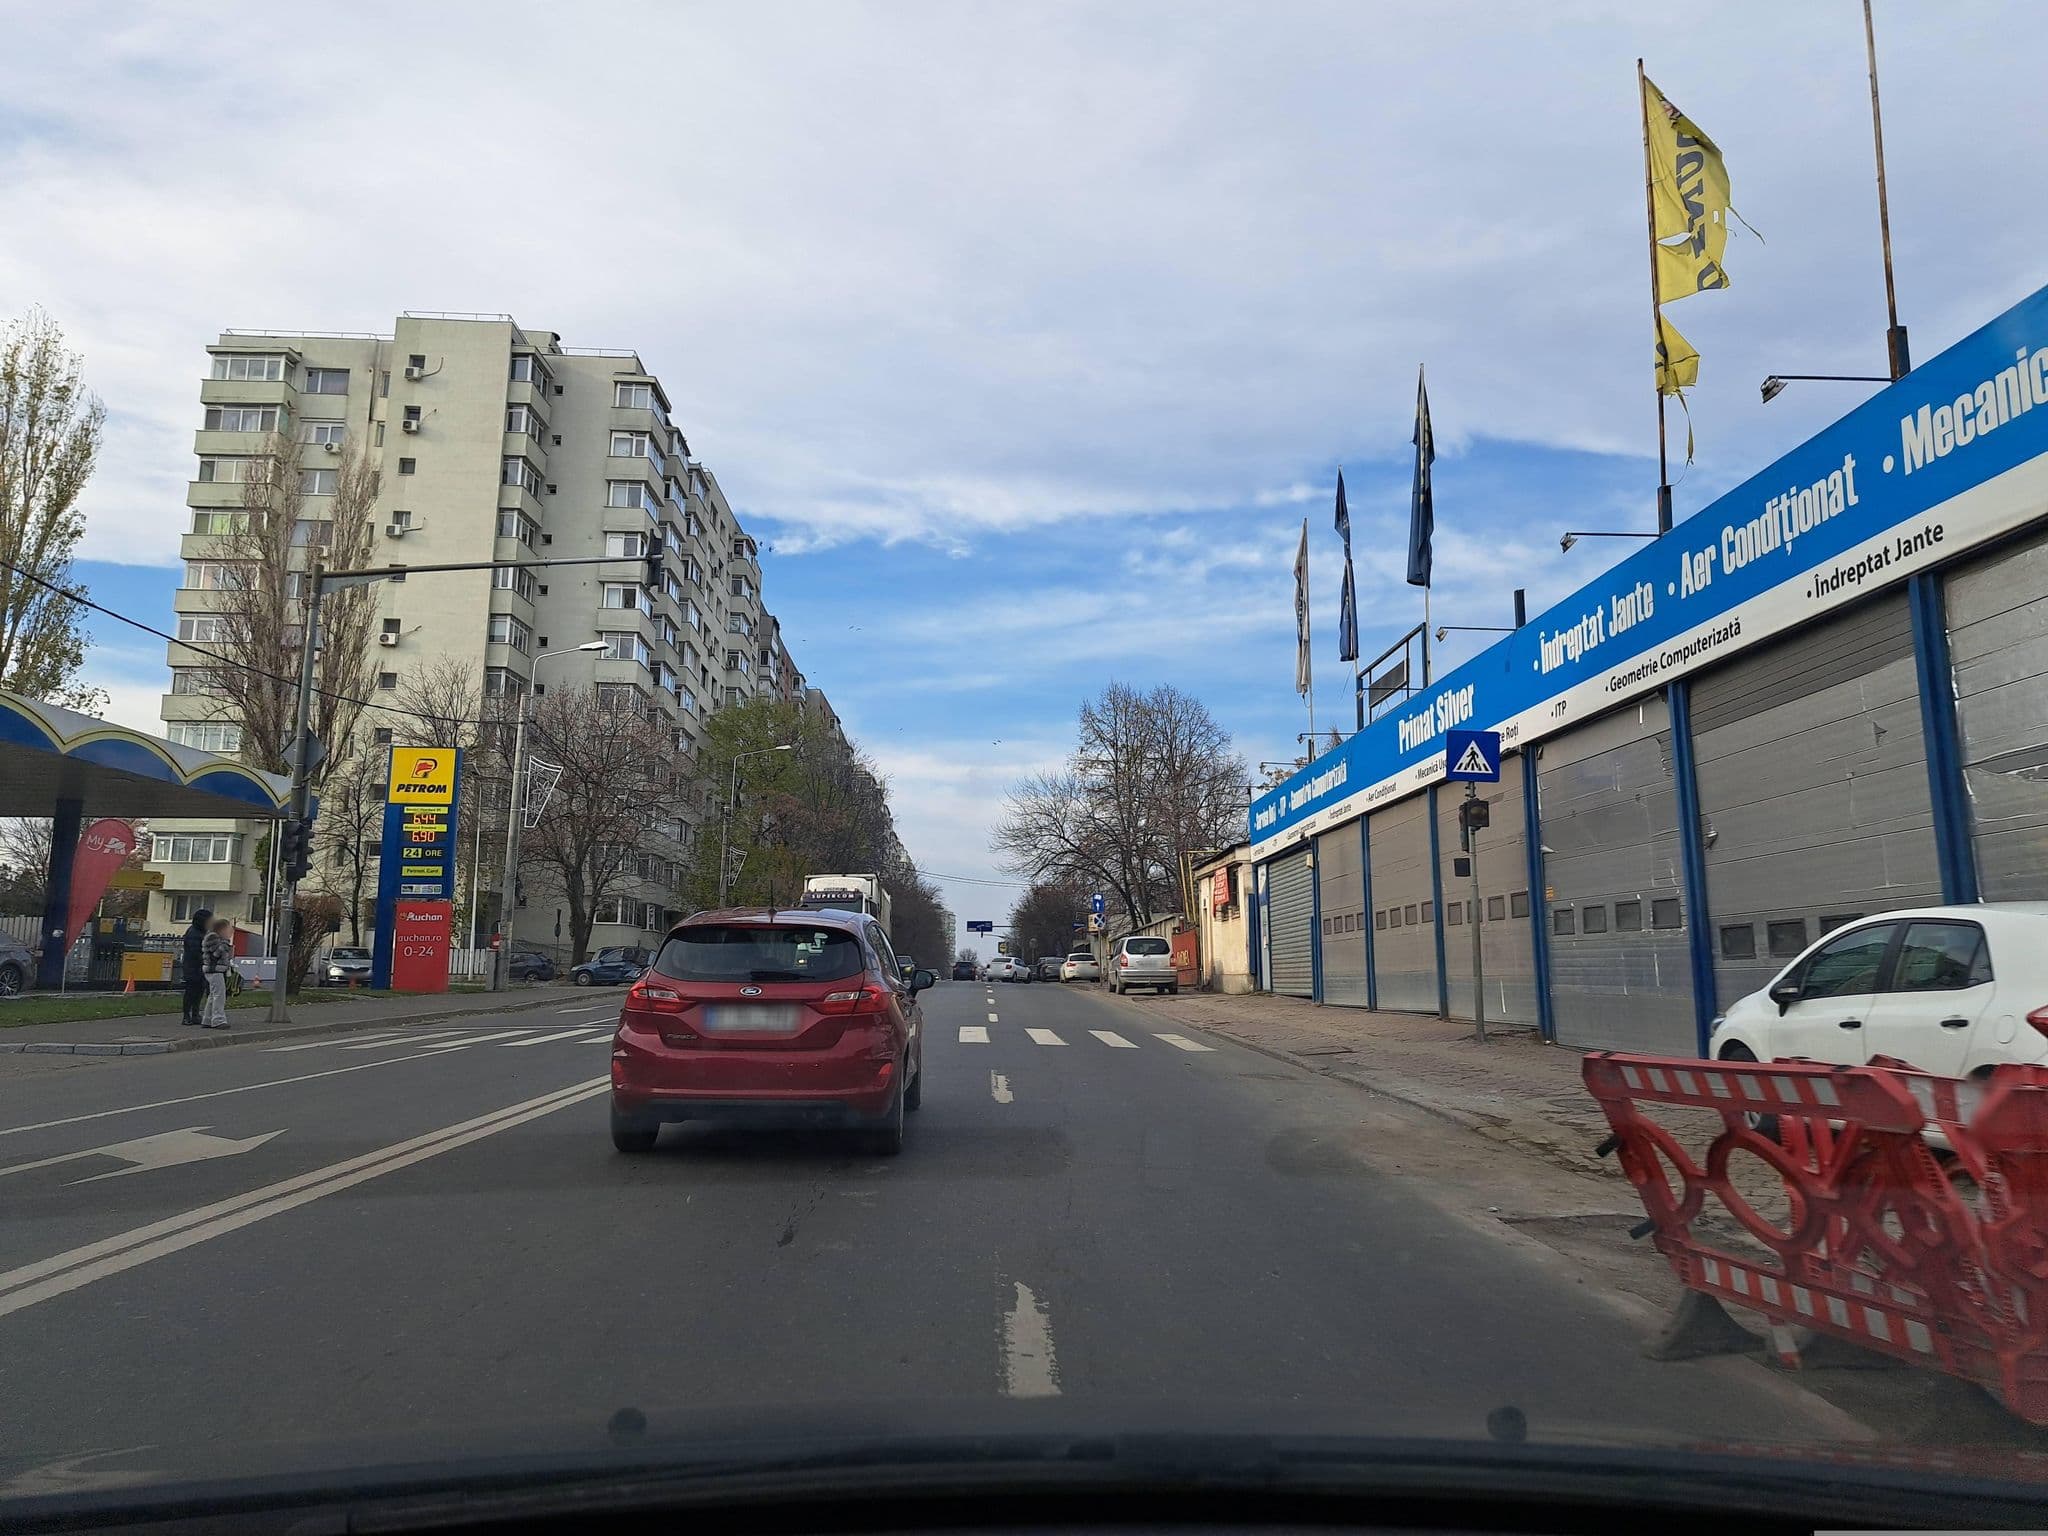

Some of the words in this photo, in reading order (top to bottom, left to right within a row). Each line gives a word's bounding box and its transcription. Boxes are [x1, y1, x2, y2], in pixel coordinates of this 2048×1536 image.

[1900, 345, 2048, 476] Mecanic
[1681, 544, 1716, 599] Aer
[1721, 453, 1859, 575] Condiționat
[1814, 546, 1892, 598] Îndreptat
[1895, 524, 1944, 562] Jante
[1539, 604, 1606, 675] Îndreptat
[1609, 581, 1654, 638] Jante
[1610, 659, 1658, 692] Geometrie
[1660, 616, 1741, 669] Computerizată
[1554, 700, 1567, 718] ITP
[1399, 704, 1435, 755] Primat
[1436, 683, 1474, 734] Silver
[396, 783, 447, 793] PETROM
[86, 835, 104, 850] My
[405, 848, 419, 857] 24
[425, 849, 443, 857] ORE
[407, 912, 443, 921] Auchan
[399, 934, 442, 942] auchan.ro
[403, 946, 434, 957] 0-24
